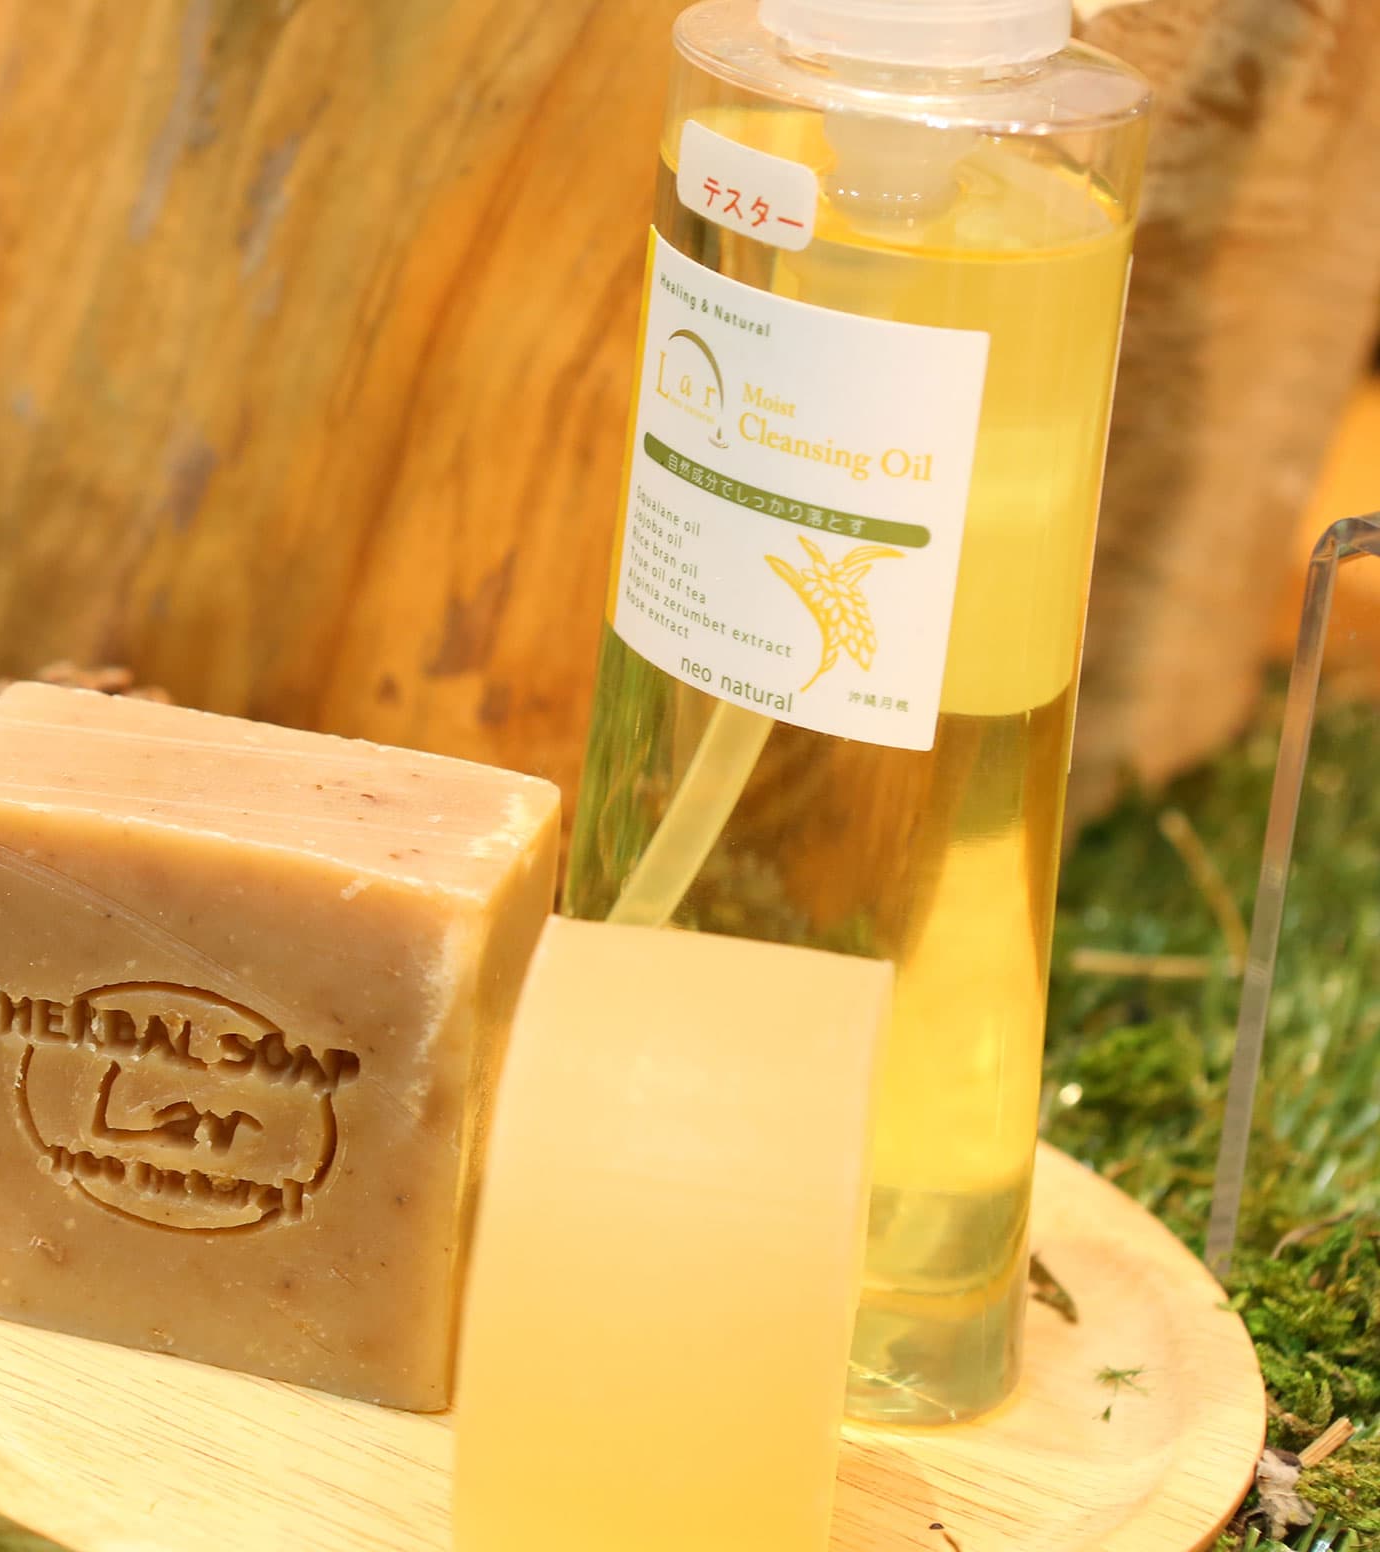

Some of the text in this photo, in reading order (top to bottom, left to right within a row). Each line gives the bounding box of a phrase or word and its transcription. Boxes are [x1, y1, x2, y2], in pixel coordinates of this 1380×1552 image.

[703, 177, 804, 228] テスター
[660, 273, 771, 337] Healing & Natural
[742, 382, 796, 418] Moist
[739, 412, 933, 482] Cleansing Oil
[636, 484, 701, 537] Squalane oil
[668, 454, 867, 534] 自然成分でしっかり落とす
[632, 525, 698, 579] Rice bran oil
[634, 507, 683, 549] Jojoba oil
[630, 545, 706, 605] True oil of tea
[626, 586, 689, 639] Rose extract
[628, 567, 793, 658] Alpinia zerumbet extract
[680, 655, 793, 713] neo natural
[217, 1032, 361, 1094] SOAP
